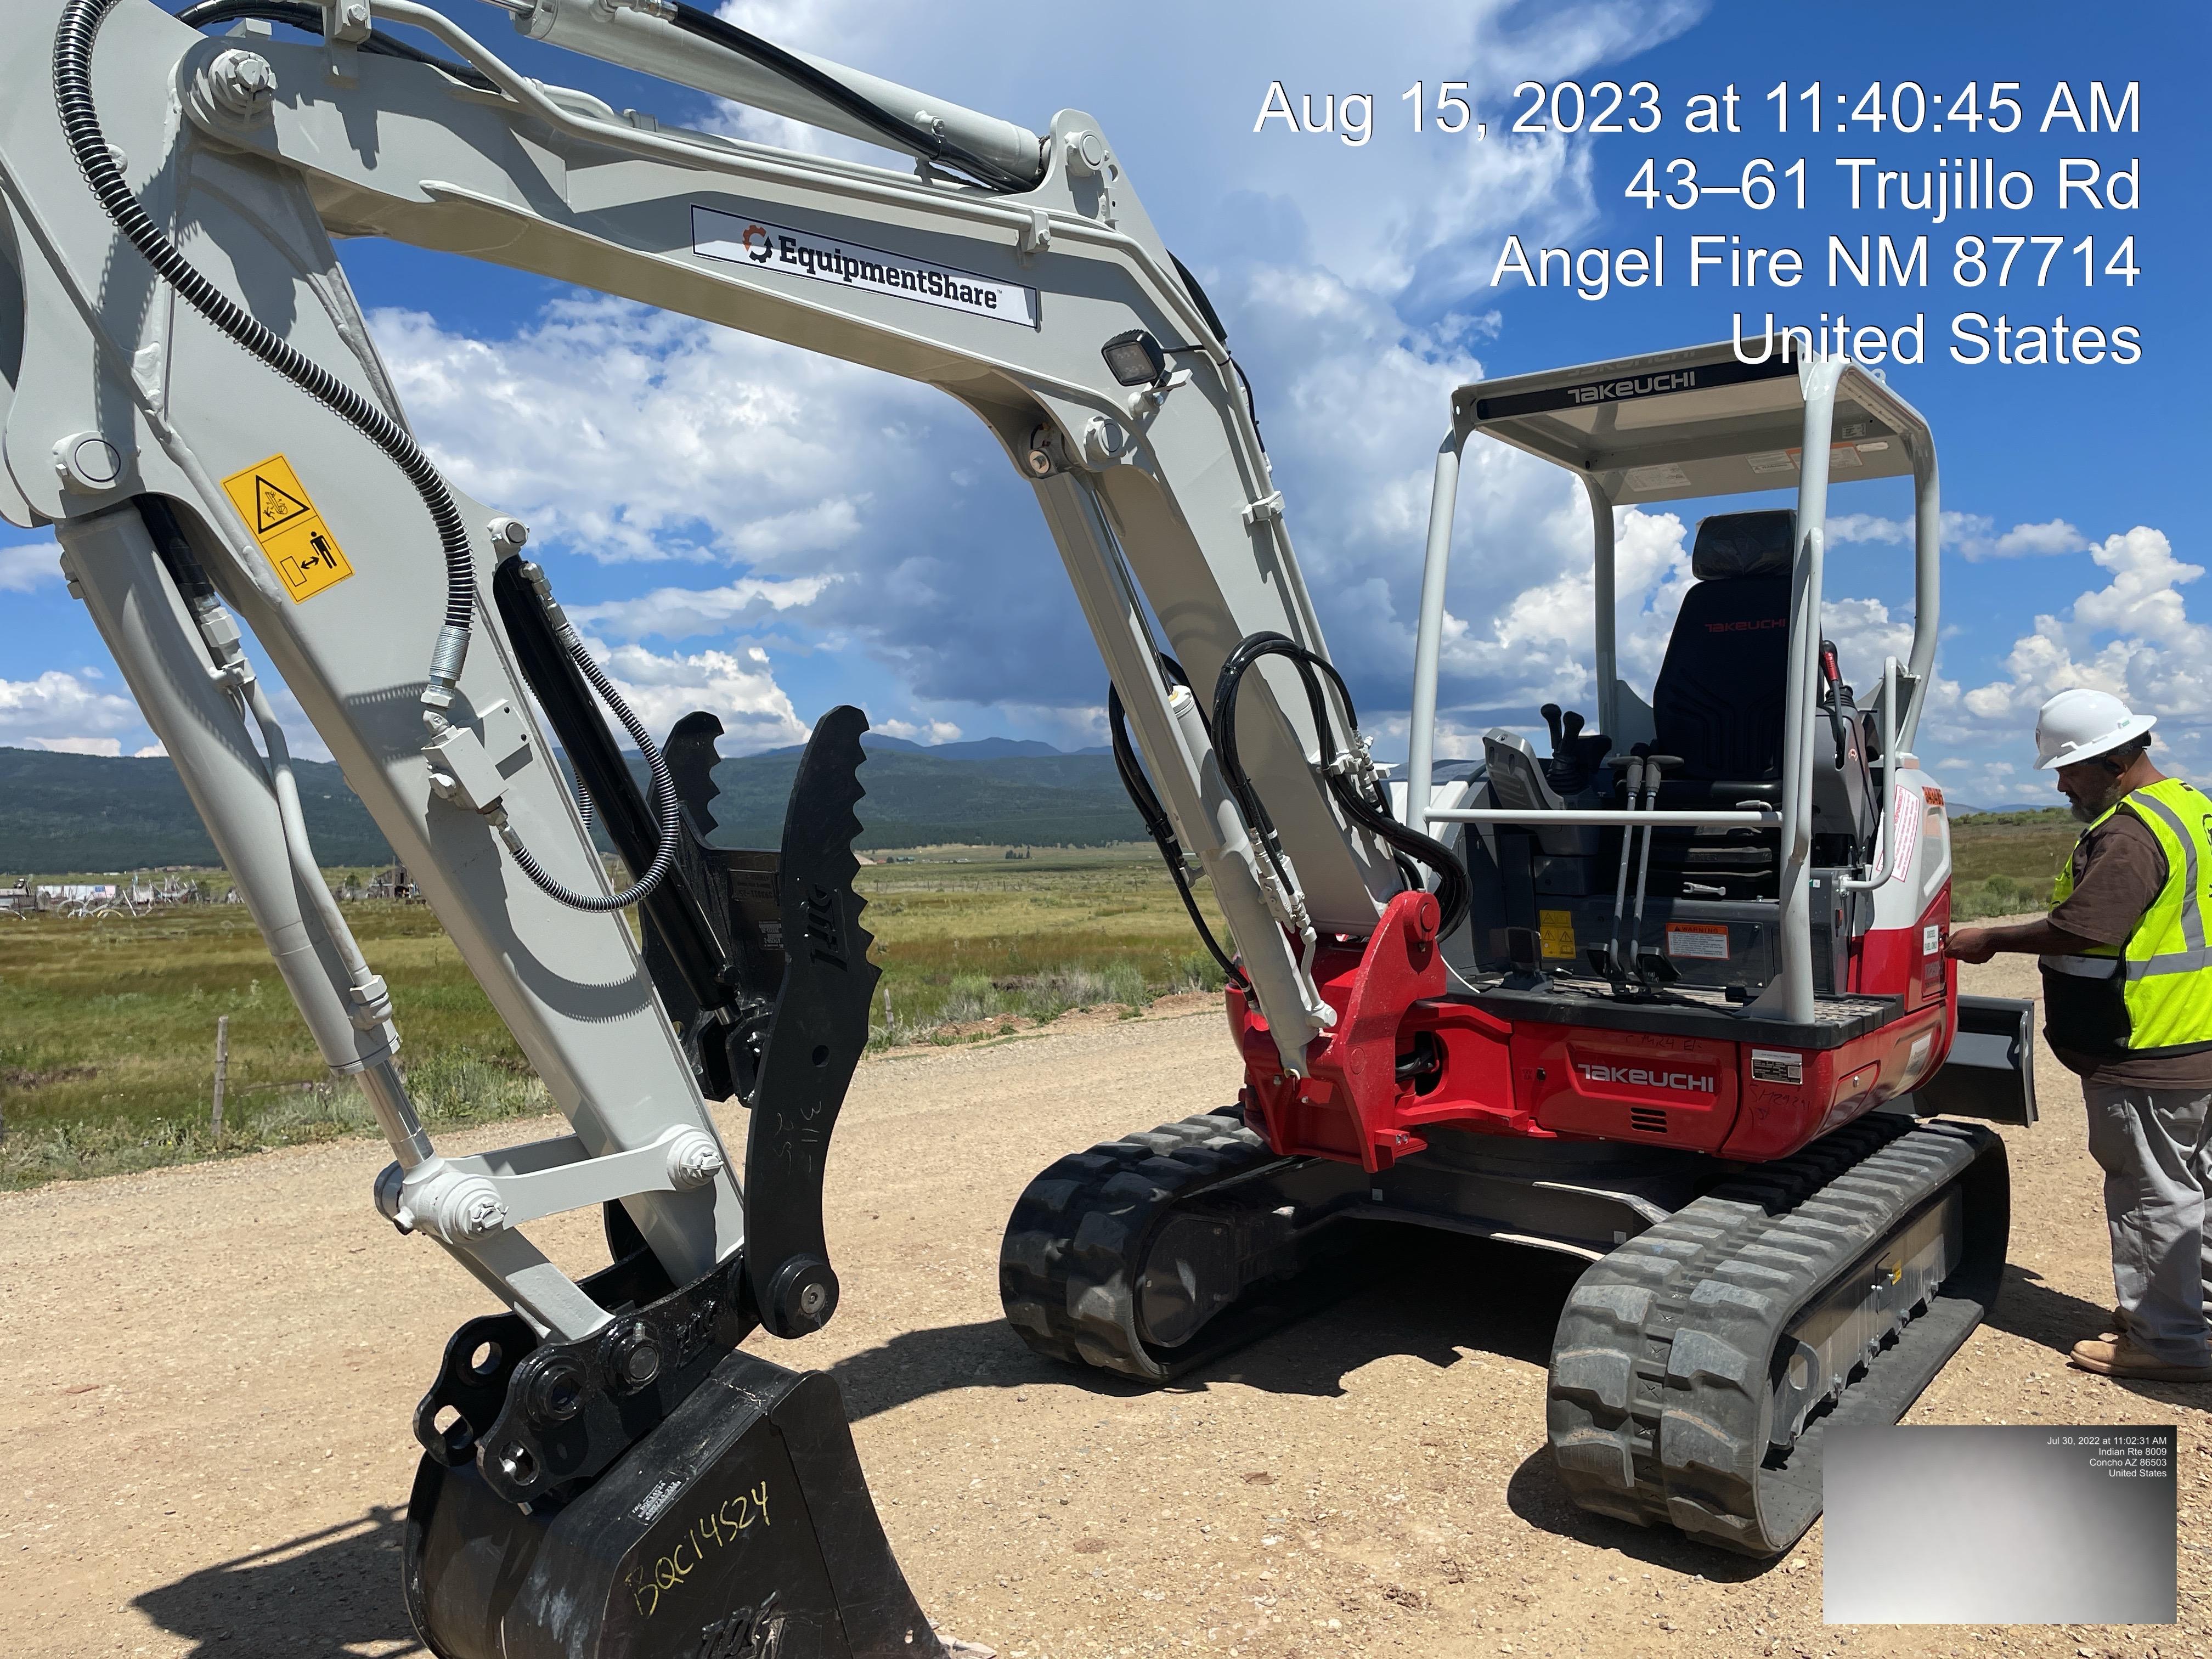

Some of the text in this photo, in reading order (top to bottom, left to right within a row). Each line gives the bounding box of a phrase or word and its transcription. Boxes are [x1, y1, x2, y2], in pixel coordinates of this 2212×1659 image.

[1567, 371, 1695, 403] TAKEUCHI
[1705, 618, 1785, 633] TAKEUCHI
[1578, 1063, 1713, 1092] TAKEUCHI
